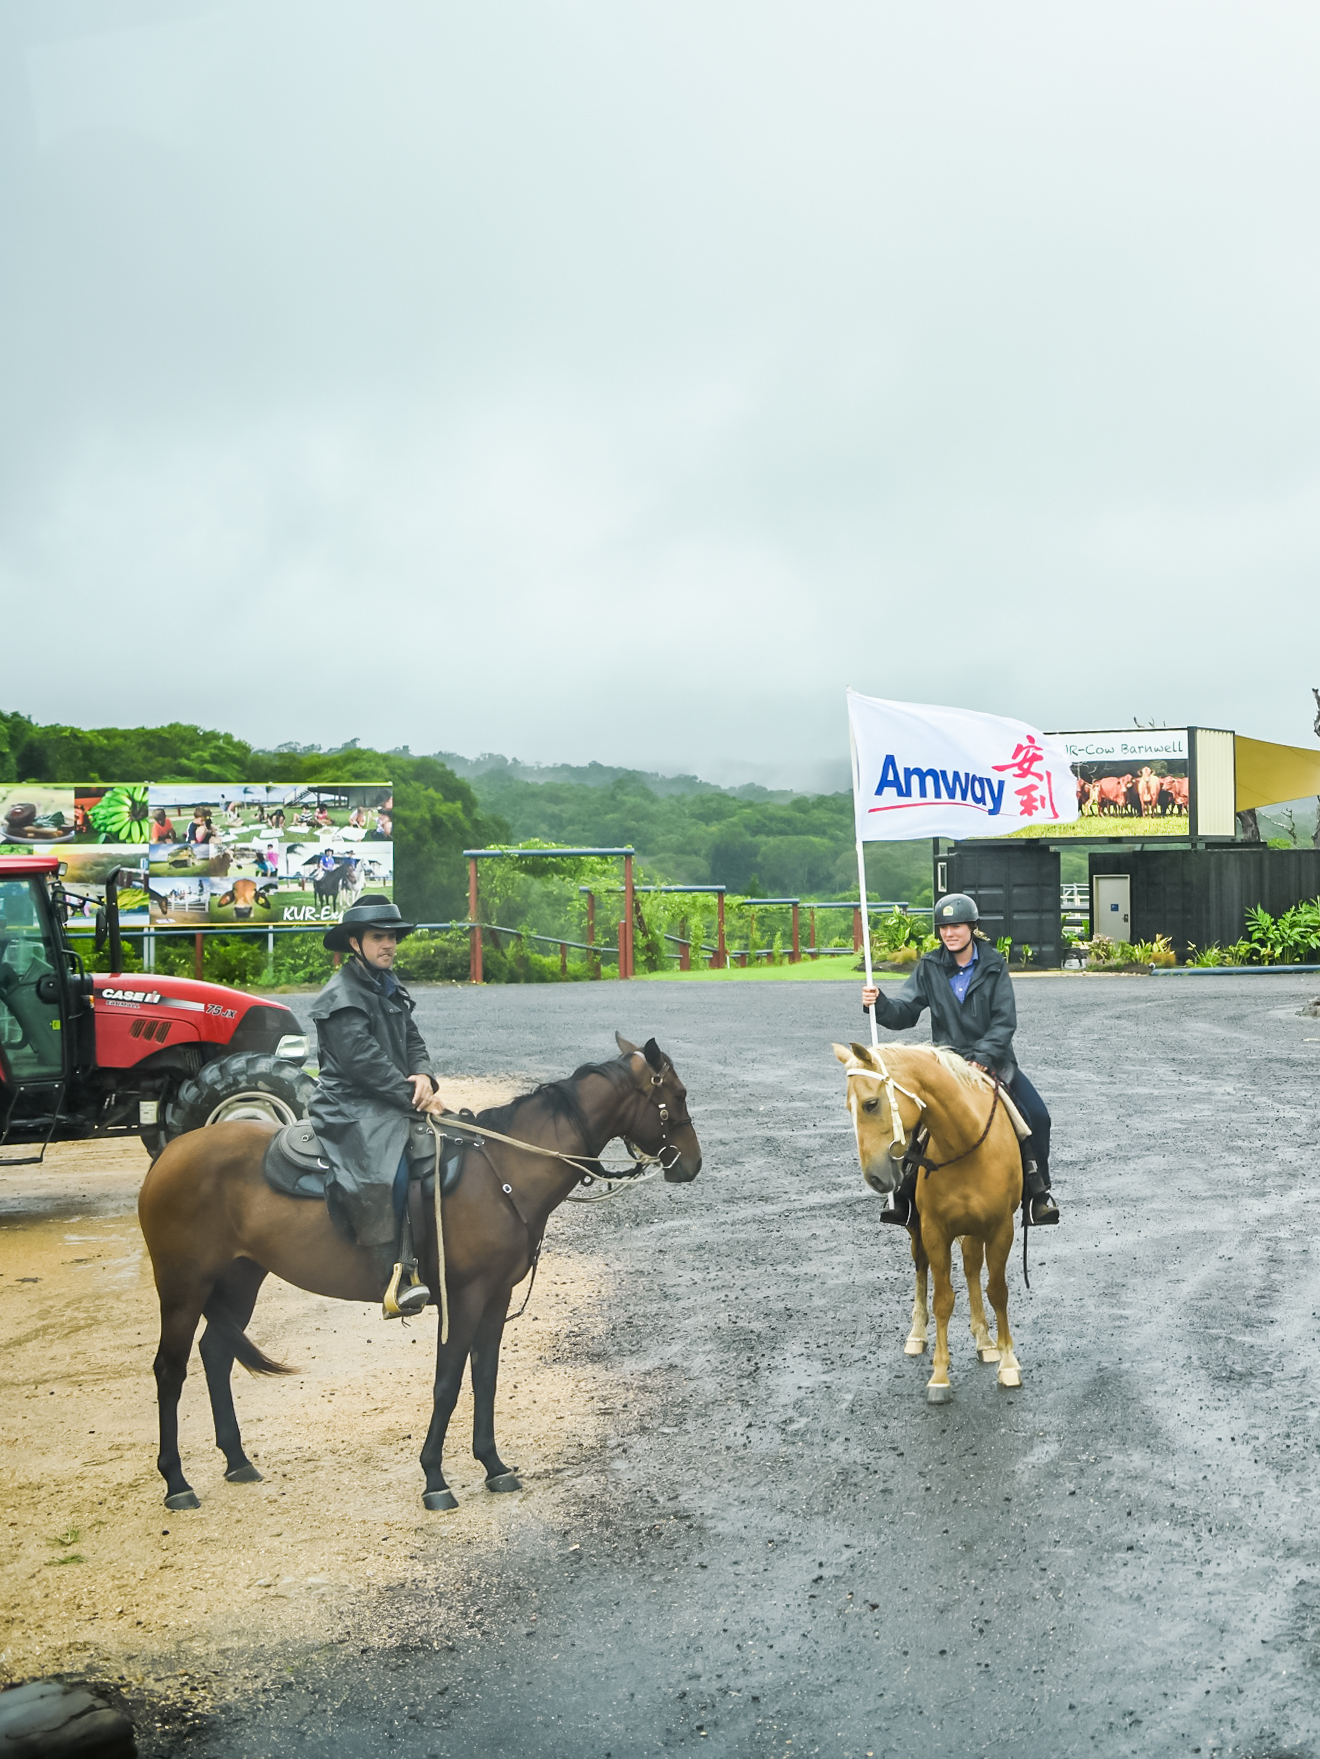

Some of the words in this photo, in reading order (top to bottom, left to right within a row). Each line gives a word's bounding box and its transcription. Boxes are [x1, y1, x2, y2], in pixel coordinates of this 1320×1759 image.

[1121, 741, 1184, 754] Barnwell
[874, 754, 1006, 815] Amway
[991, 735, 1060, 819] 安利
[102, 988, 145, 1002] CASE
[206, 1004, 222, 1015] 75
[222, 1009, 237, 1019] JX
